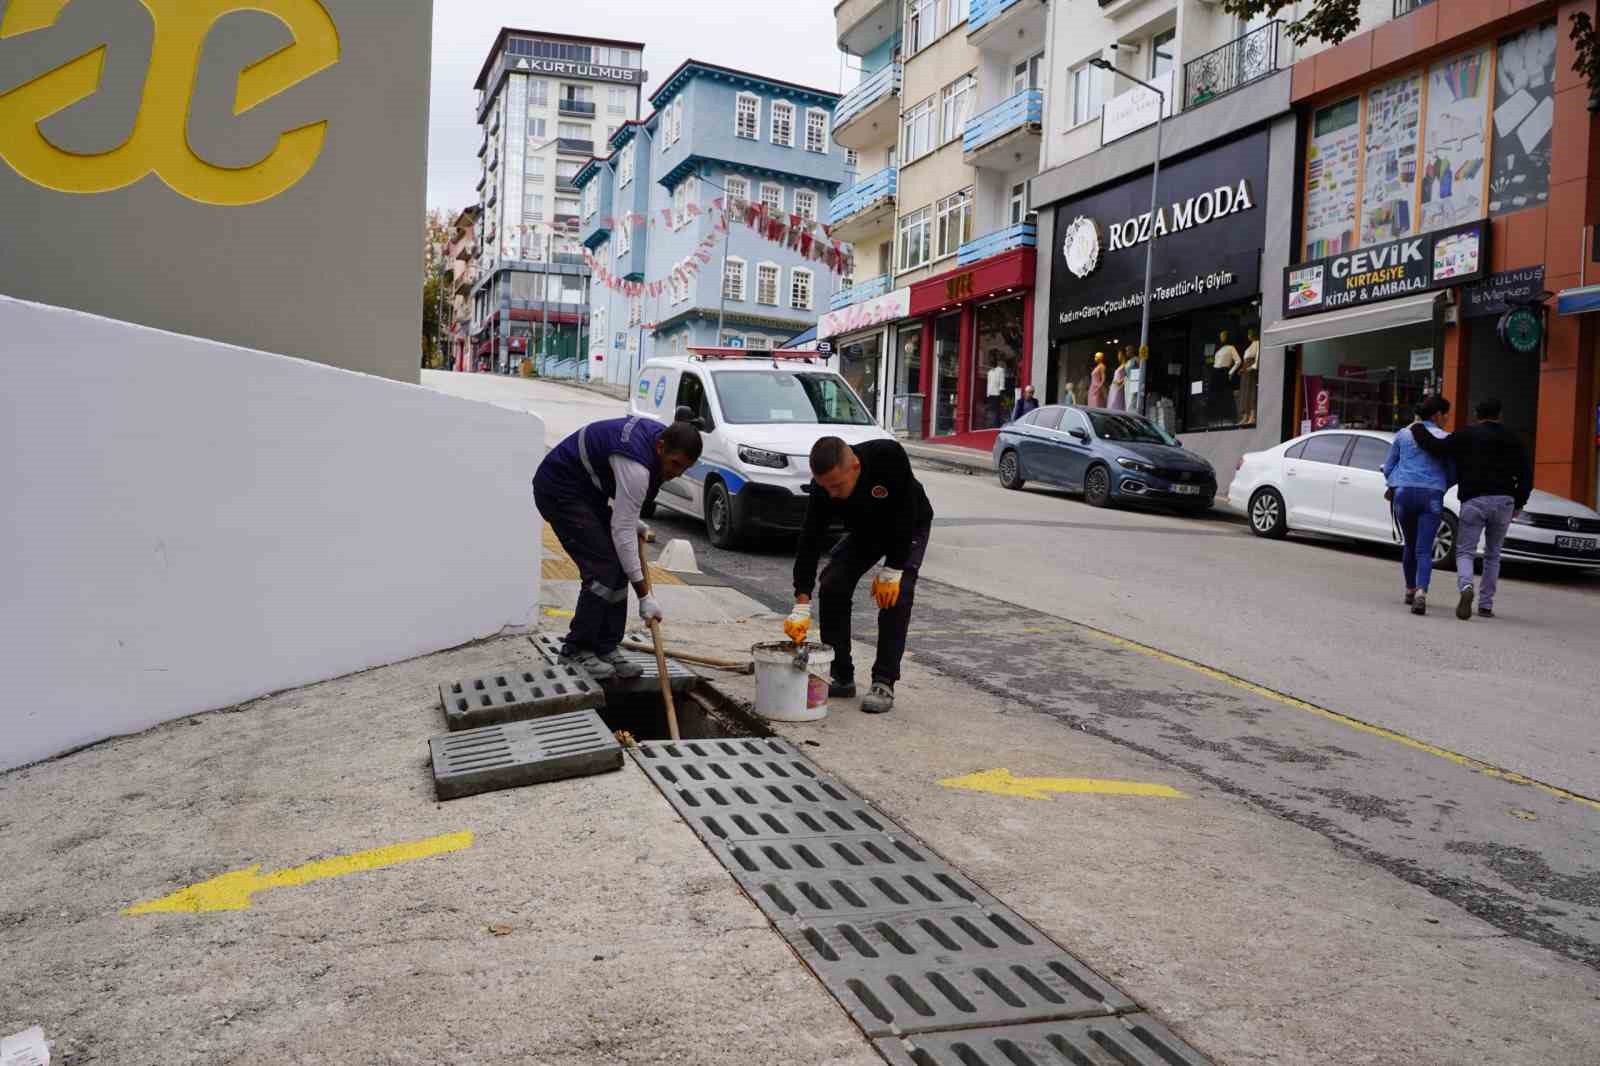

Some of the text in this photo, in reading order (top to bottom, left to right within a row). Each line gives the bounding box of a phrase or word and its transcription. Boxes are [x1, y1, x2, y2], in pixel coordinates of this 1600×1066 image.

[1108, 207, 1168, 251] ROZA
[1172, 179, 1252, 232] MODA
[1325, 275, 1428, 307] KİTAP & AMBALAJ
